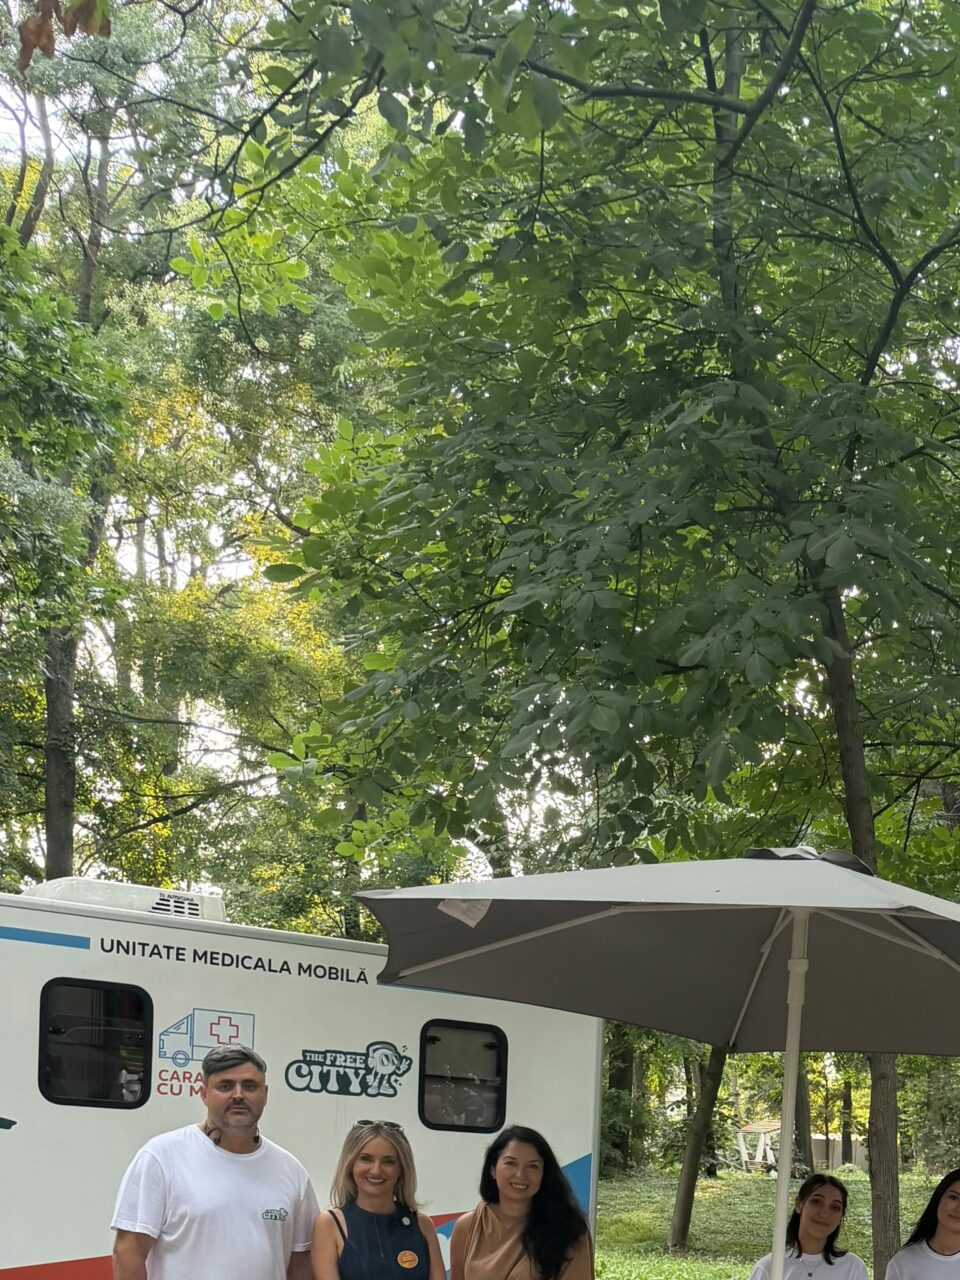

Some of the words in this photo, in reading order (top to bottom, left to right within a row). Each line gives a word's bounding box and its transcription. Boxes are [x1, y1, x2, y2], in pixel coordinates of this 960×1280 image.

[100, 937, 186, 962] UNITATE
[193, 949, 292, 975] MEDICALA
[298, 962, 369, 985] MOBILĂ
[305, 1052, 325, 1062] THE
[326, 1052, 366, 1068] FREE
[158, 1069, 203, 1083] CARA
[287, 1062, 366, 1094] CITY
[156, 1083, 183, 1096] CU
